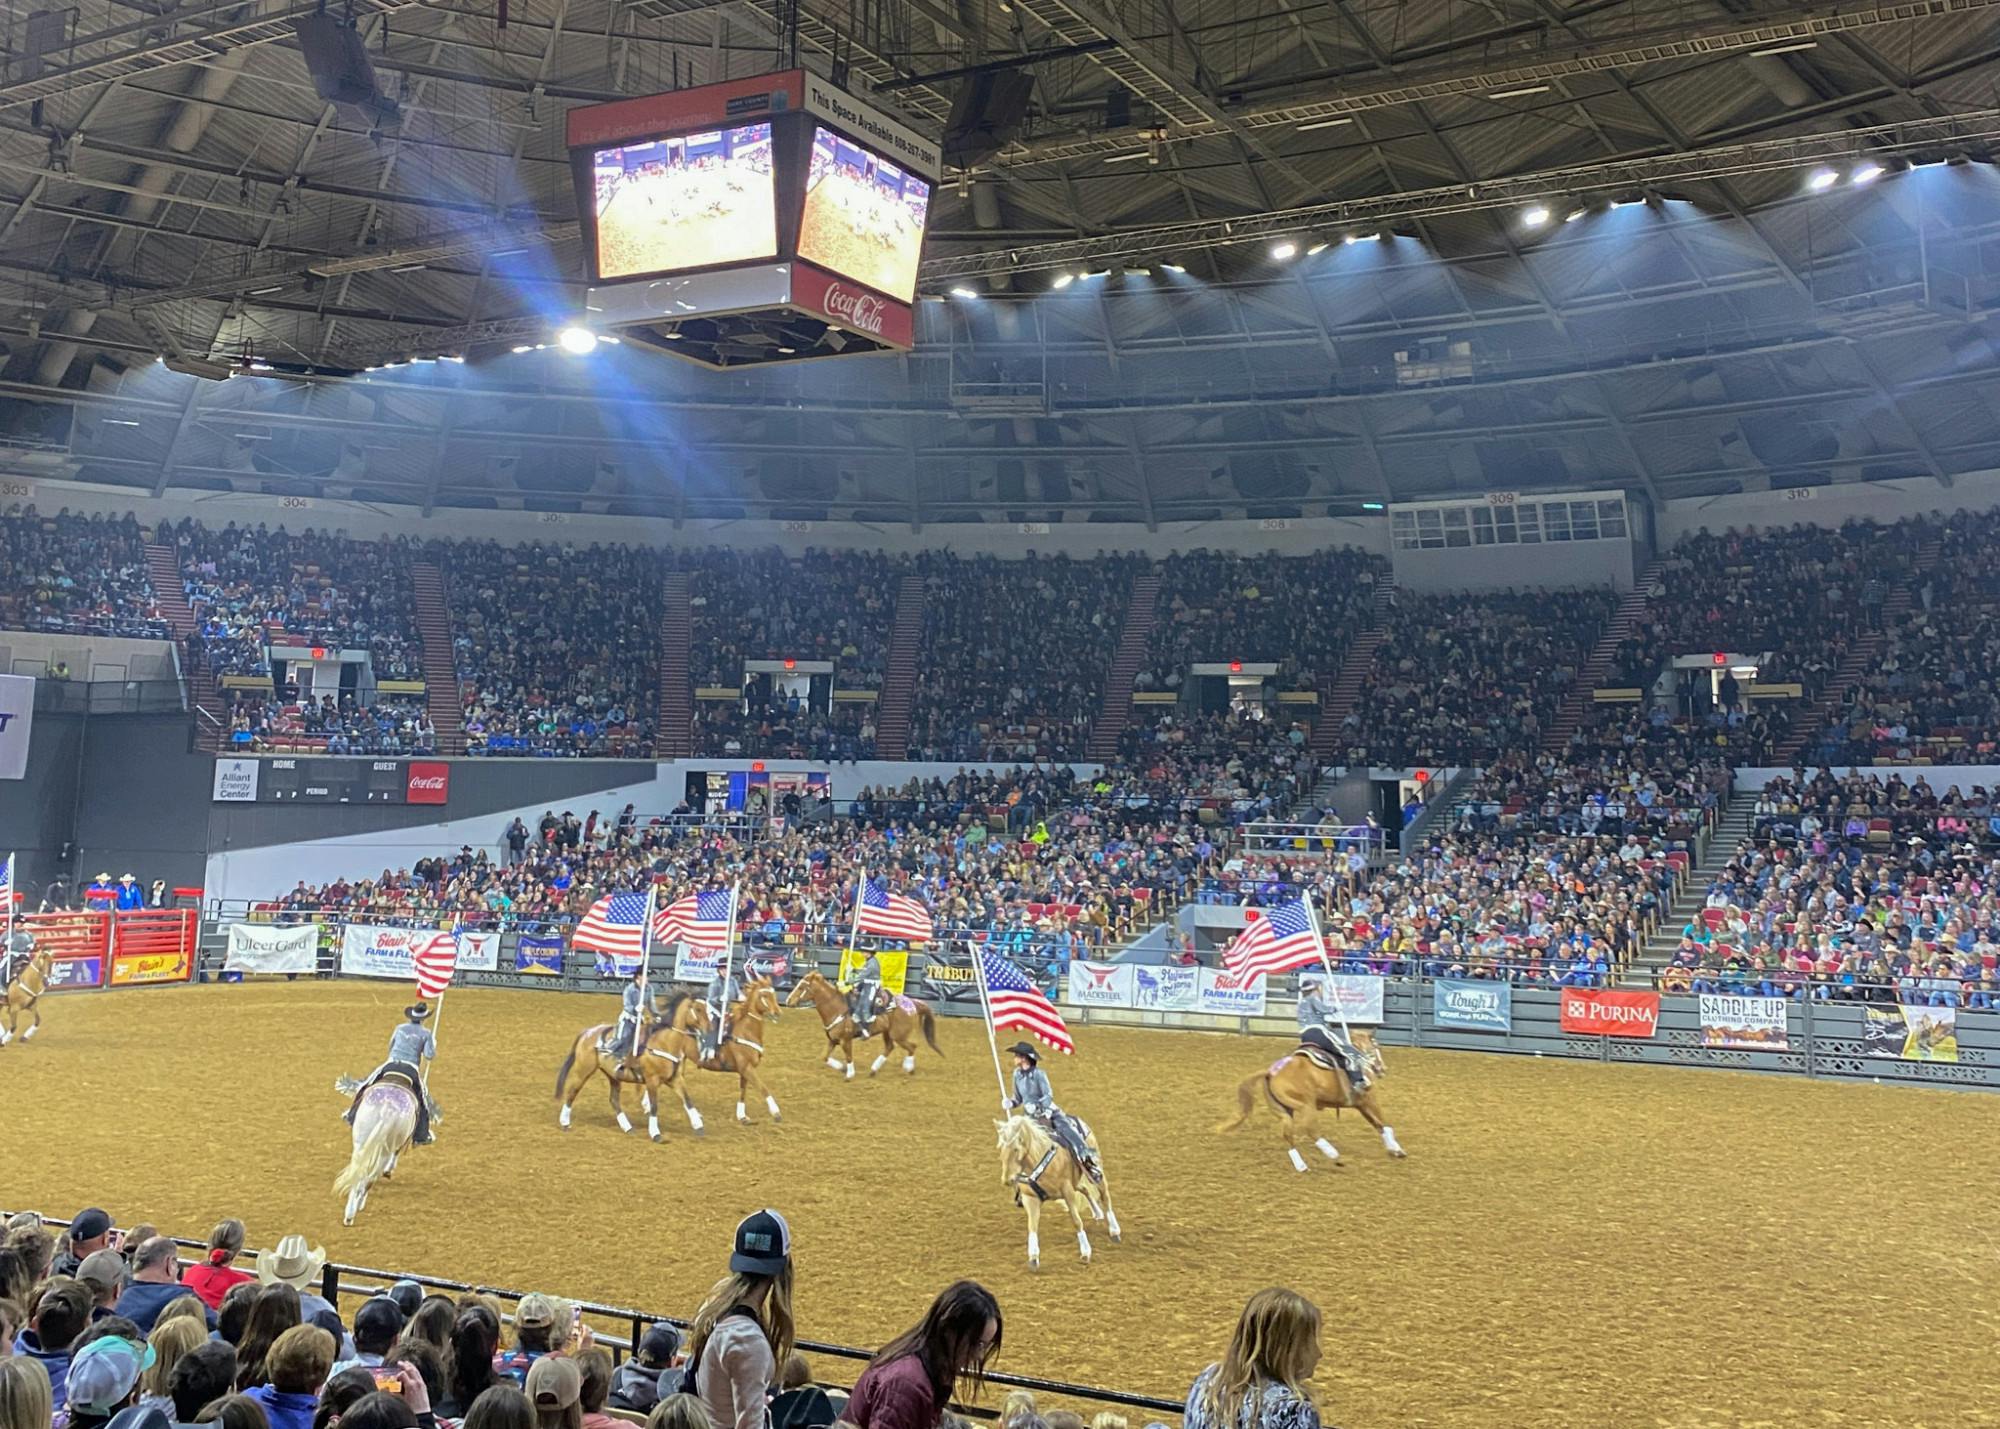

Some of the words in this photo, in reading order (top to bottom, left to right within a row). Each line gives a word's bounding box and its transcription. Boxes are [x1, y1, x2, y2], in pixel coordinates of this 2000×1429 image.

[812, 88, 829, 110] This
[832, 99, 856, 124] Space
[858, 114, 893, 143] Available
[824, 282, 887, 333] Coca-Cola
[2, 484, 28, 496] 303
[1787, 489, 1809, 500] 310
[283, 497, 306, 507] 304
[1490, 493, 1514, 504] 309
[272, 760, 295, 769] HOME
[373, 762, 397, 770] GUEST
[222, 773, 250, 781] Alliant
[410, 776, 445, 789] Coca-Cola
[220, 781, 251, 790] Energy
[306, 787, 328, 795] PERIOD
[220, 790, 250, 798] Center
[365, 947, 387, 956] FARM
[680, 959, 697, 968] FARM
[1078, 991, 1121, 1000] MACKSTEEL
[1203, 988, 1227, 998] FARM
[1235, 991, 1260, 1000] FLEET
[1450, 991, 1486, 1010] Tough
[1487, 991, 1495, 1009] 1
[1589, 1002, 1654, 1024] PURINA
[1702, 997, 1760, 1016] SADDLE
[1765, 1000, 1784, 1018] UP
[1702, 1014, 1742, 1023] CLOTHING
[1744, 1017, 1785, 1025] COMPANY
